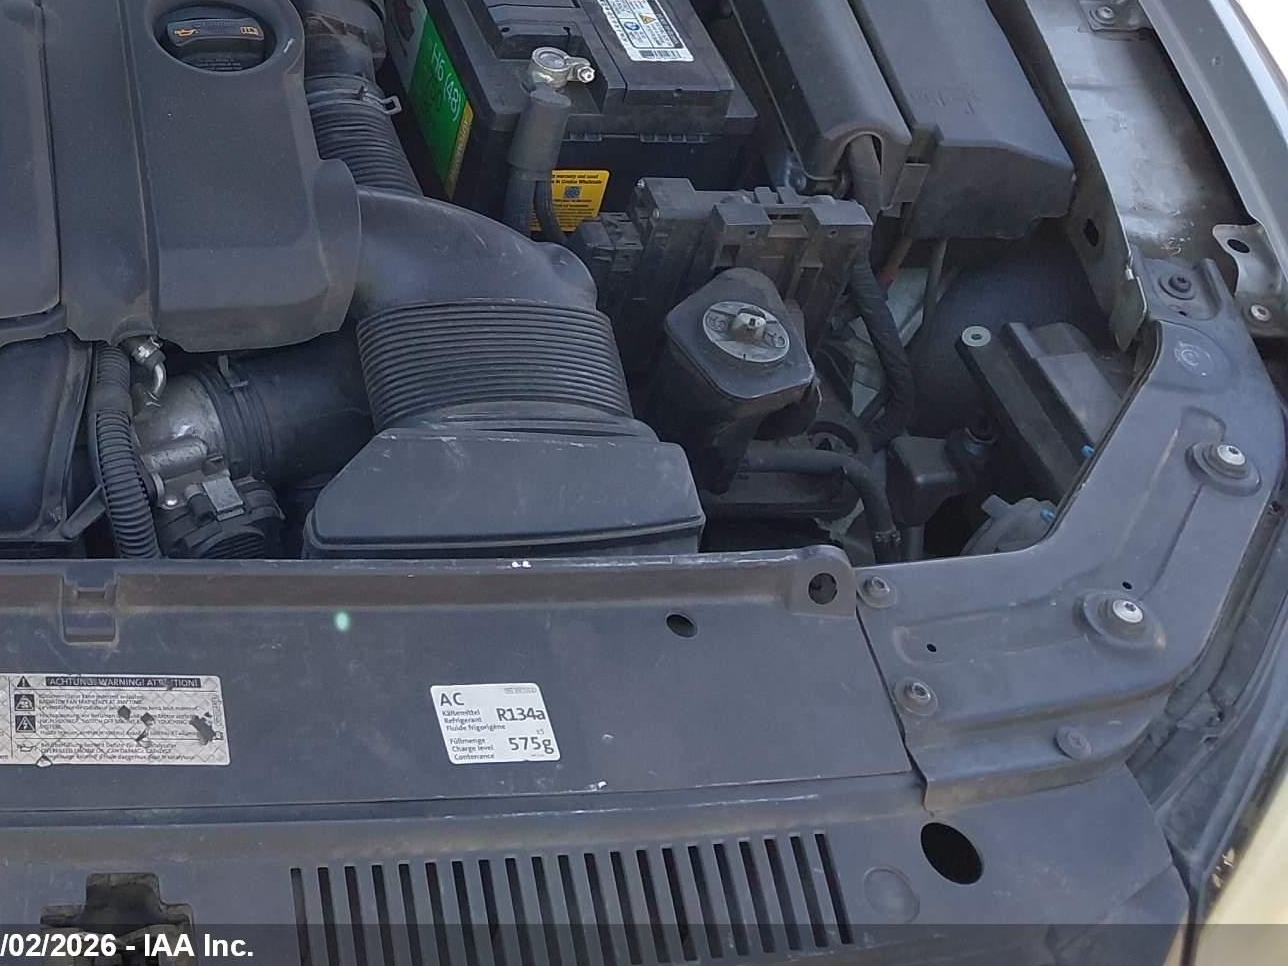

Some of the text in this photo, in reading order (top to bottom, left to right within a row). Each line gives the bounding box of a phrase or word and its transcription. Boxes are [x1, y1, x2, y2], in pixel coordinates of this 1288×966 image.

[430, 43, 444, 81] H6
[443, 73, 461, 122] (48)
[98, 678, 145, 687] WARNING!
[440, 692, 465, 707] AC
[442, 709, 480, 717] Kältemittel
[496, 707, 546, 722] R134a
[444, 717, 483, 725] Refrigerant
[468, 723, 506, 732] frigorigène
[450, 737, 486, 746] Füllmenge
[508, 737, 555, 754] 575g
[452, 745, 477, 753] Charge
